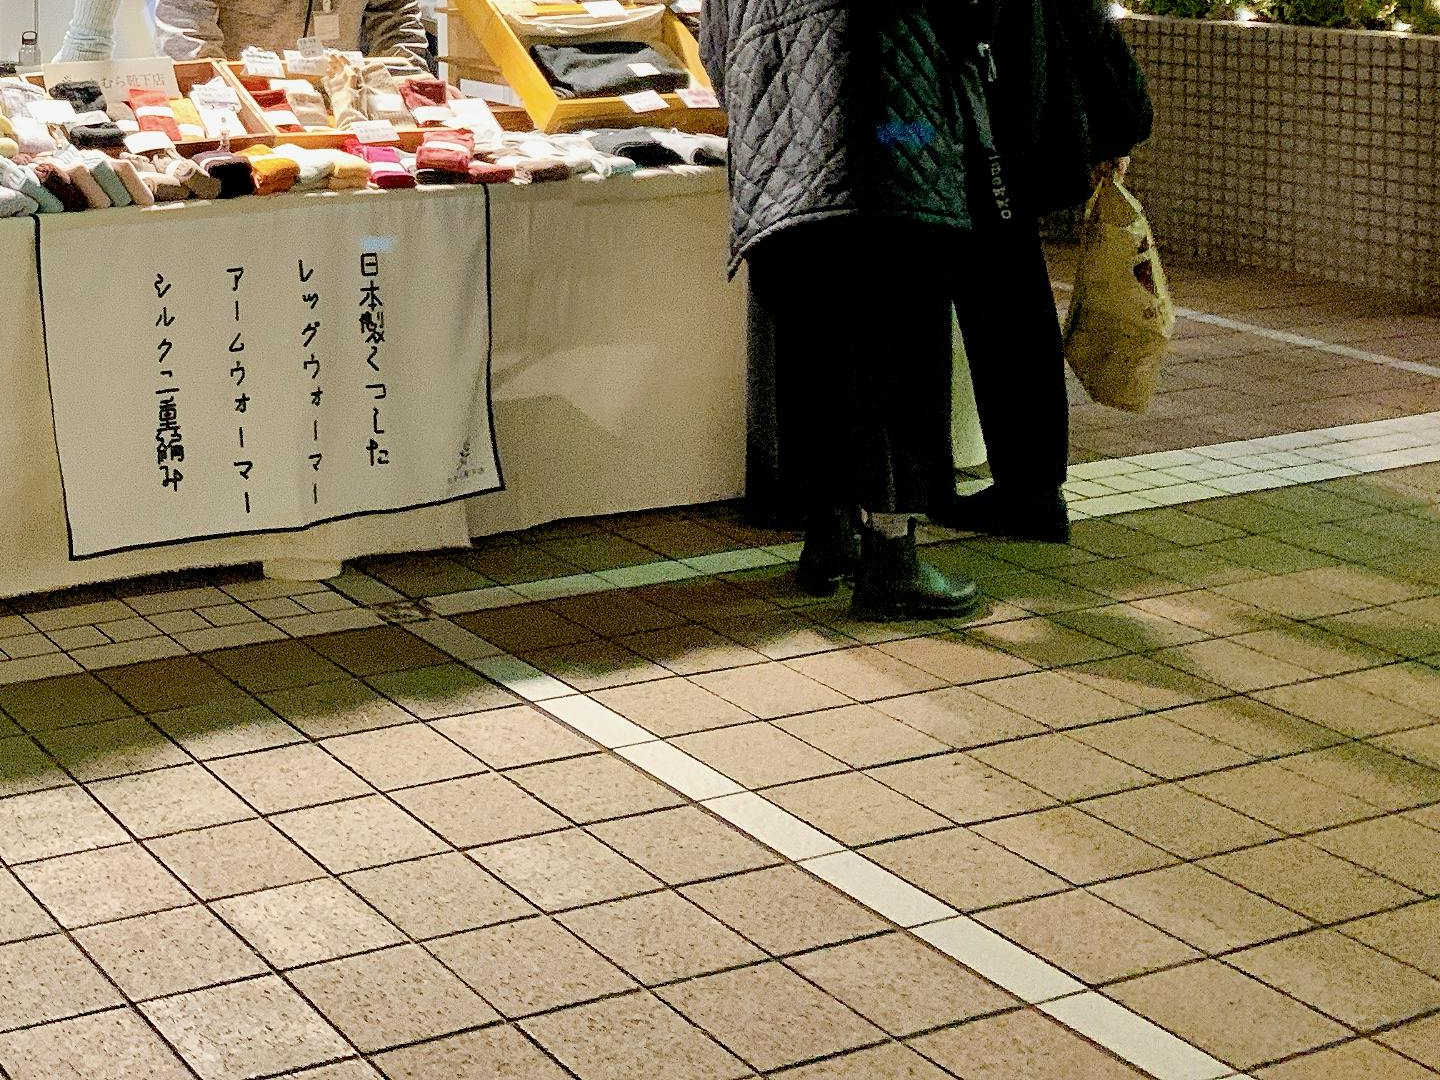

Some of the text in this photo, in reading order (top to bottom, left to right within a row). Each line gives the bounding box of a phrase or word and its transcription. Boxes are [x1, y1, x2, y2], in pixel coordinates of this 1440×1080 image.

[227, 267, 253, 513] アームウォーマー
[359, 252, 389, 466] 日本製くつした
